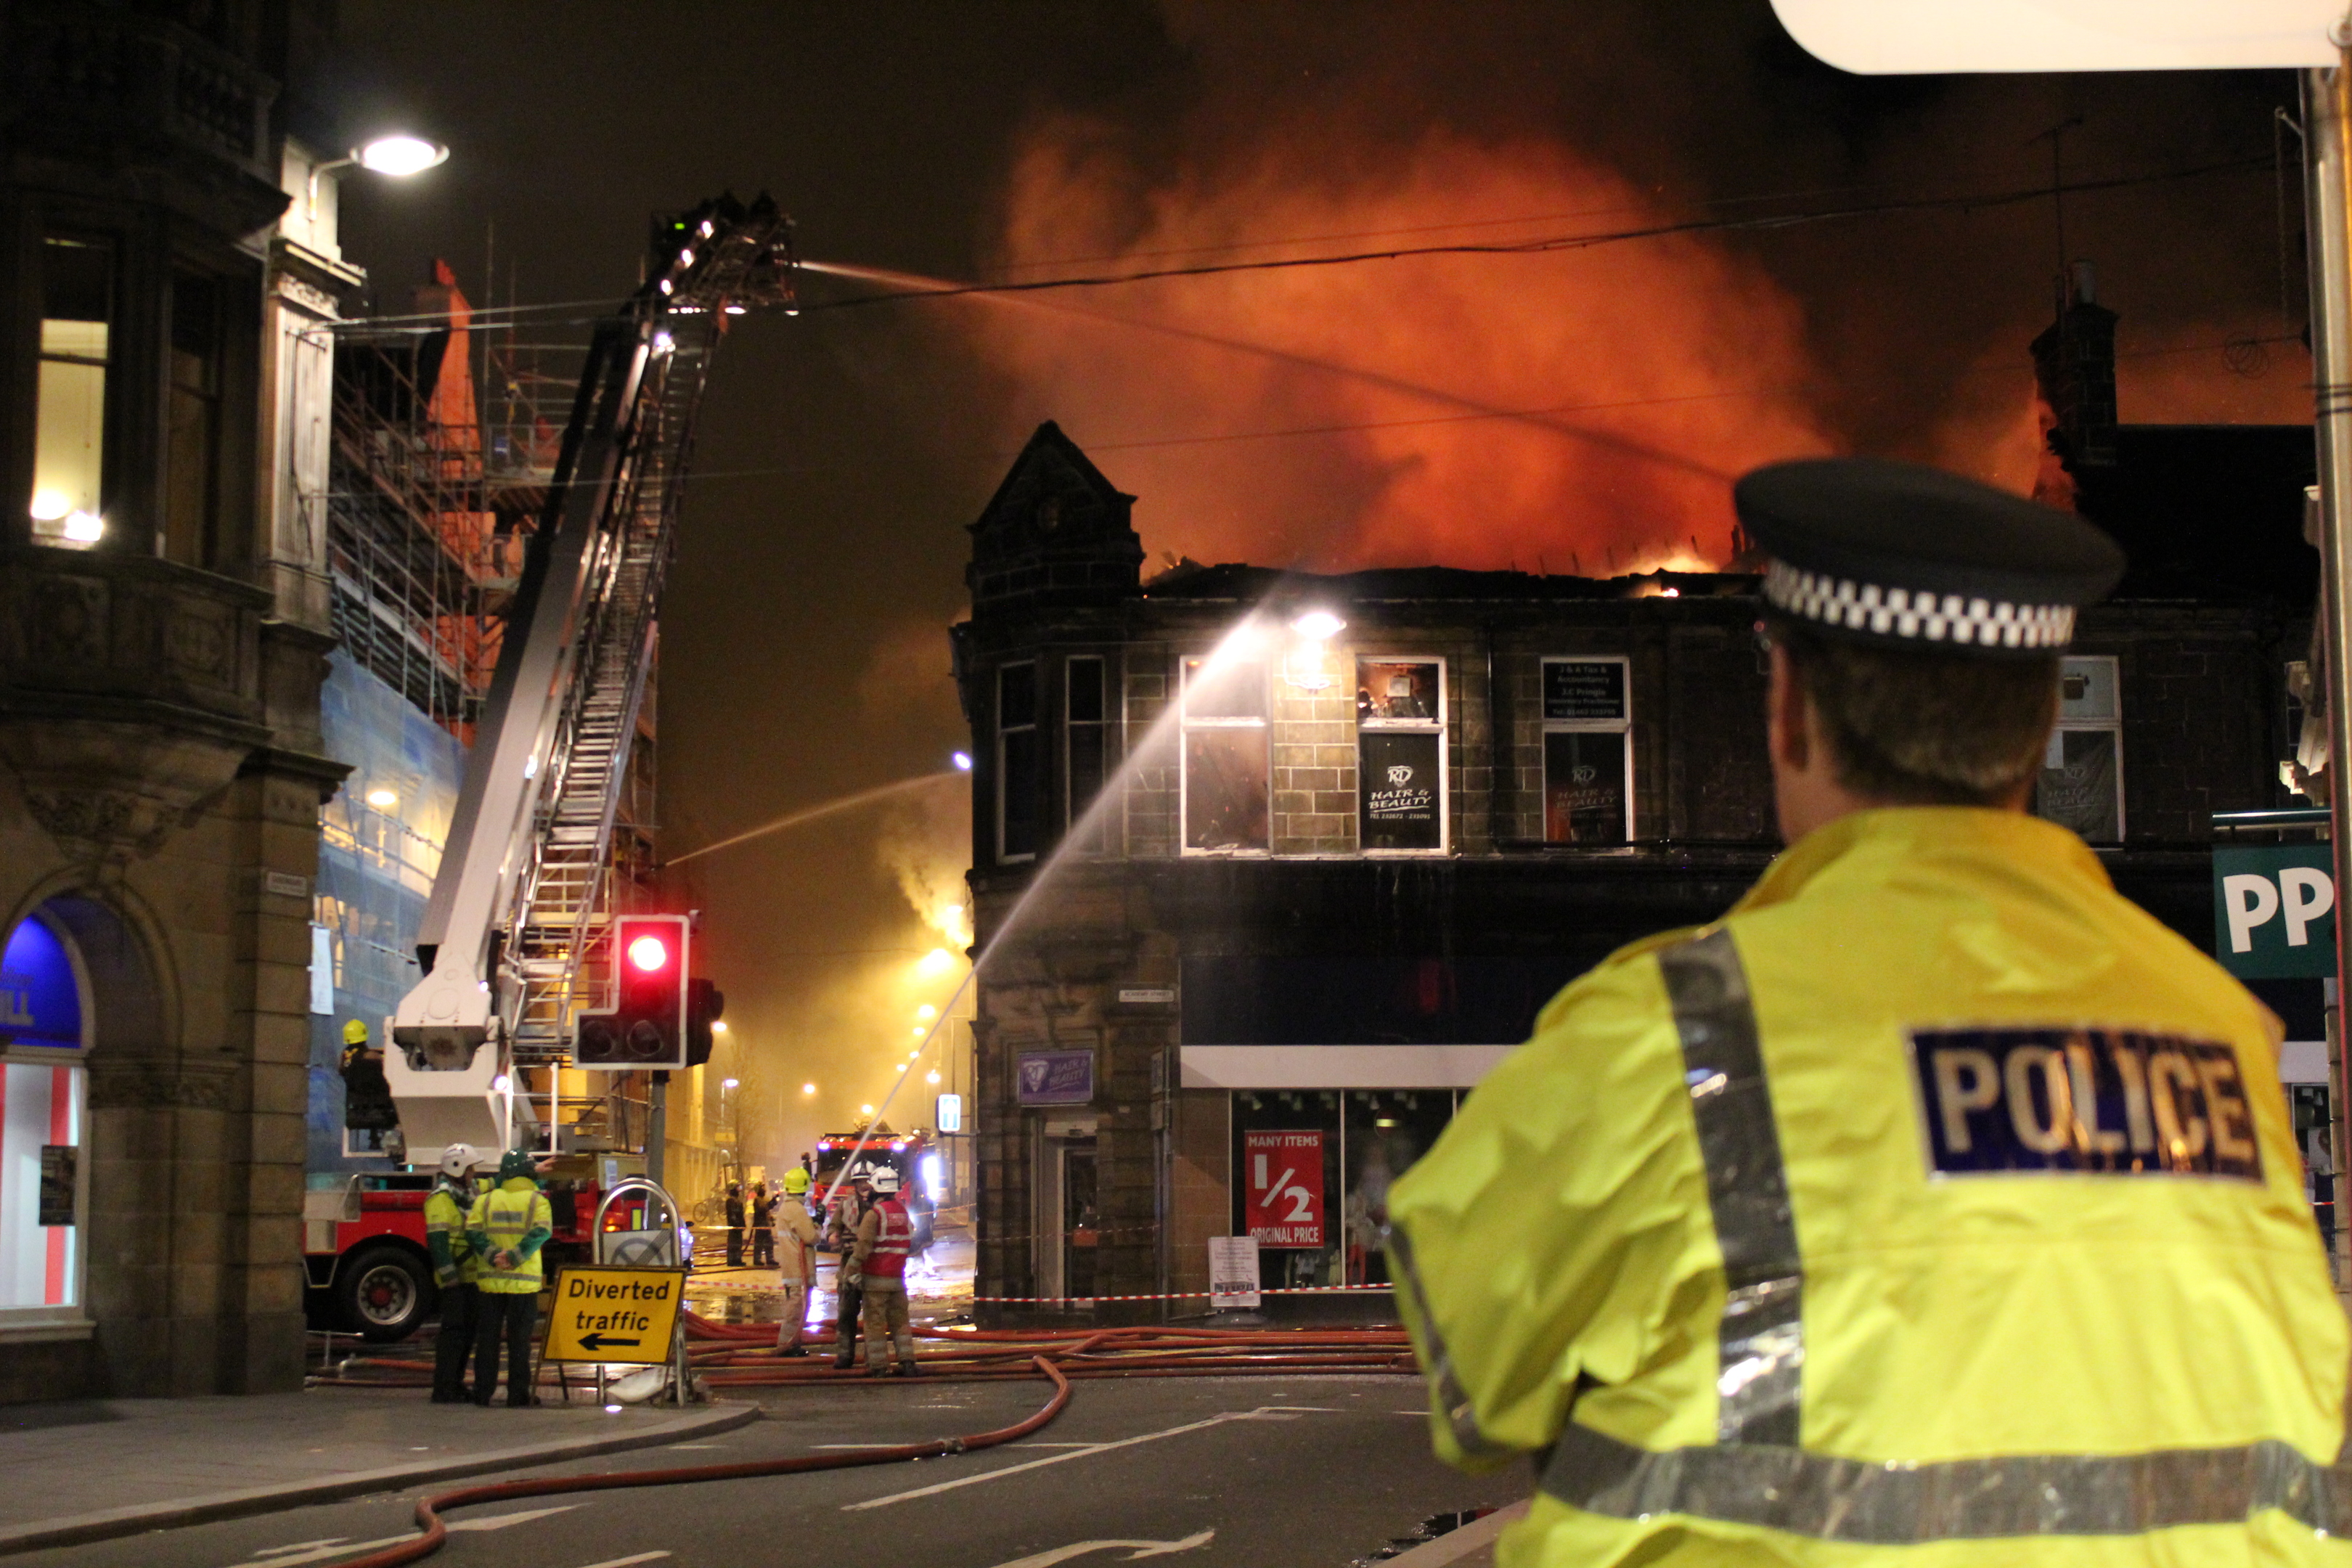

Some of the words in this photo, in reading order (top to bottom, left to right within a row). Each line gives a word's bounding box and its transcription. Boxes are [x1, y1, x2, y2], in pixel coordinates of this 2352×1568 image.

[1368, 796, 1432, 809] BEAUTY
[1370, 789, 1414, 801] HAIR
[2223, 867, 2335, 953] PP
[1930, 1043, 2254, 1160] POLICE
[1248, 1135, 1282, 1147] MANY
[1285, 1135, 1318, 1147] ITEMS
[1254, 1154, 1313, 1222] 1/2
[1250, 1227, 1292, 1243] ORIGINAL
[1294, 1227, 1319, 1243] PRICE
[568, 1278, 670, 1300] Diverted
[576, 1311, 649, 1331] traffic
